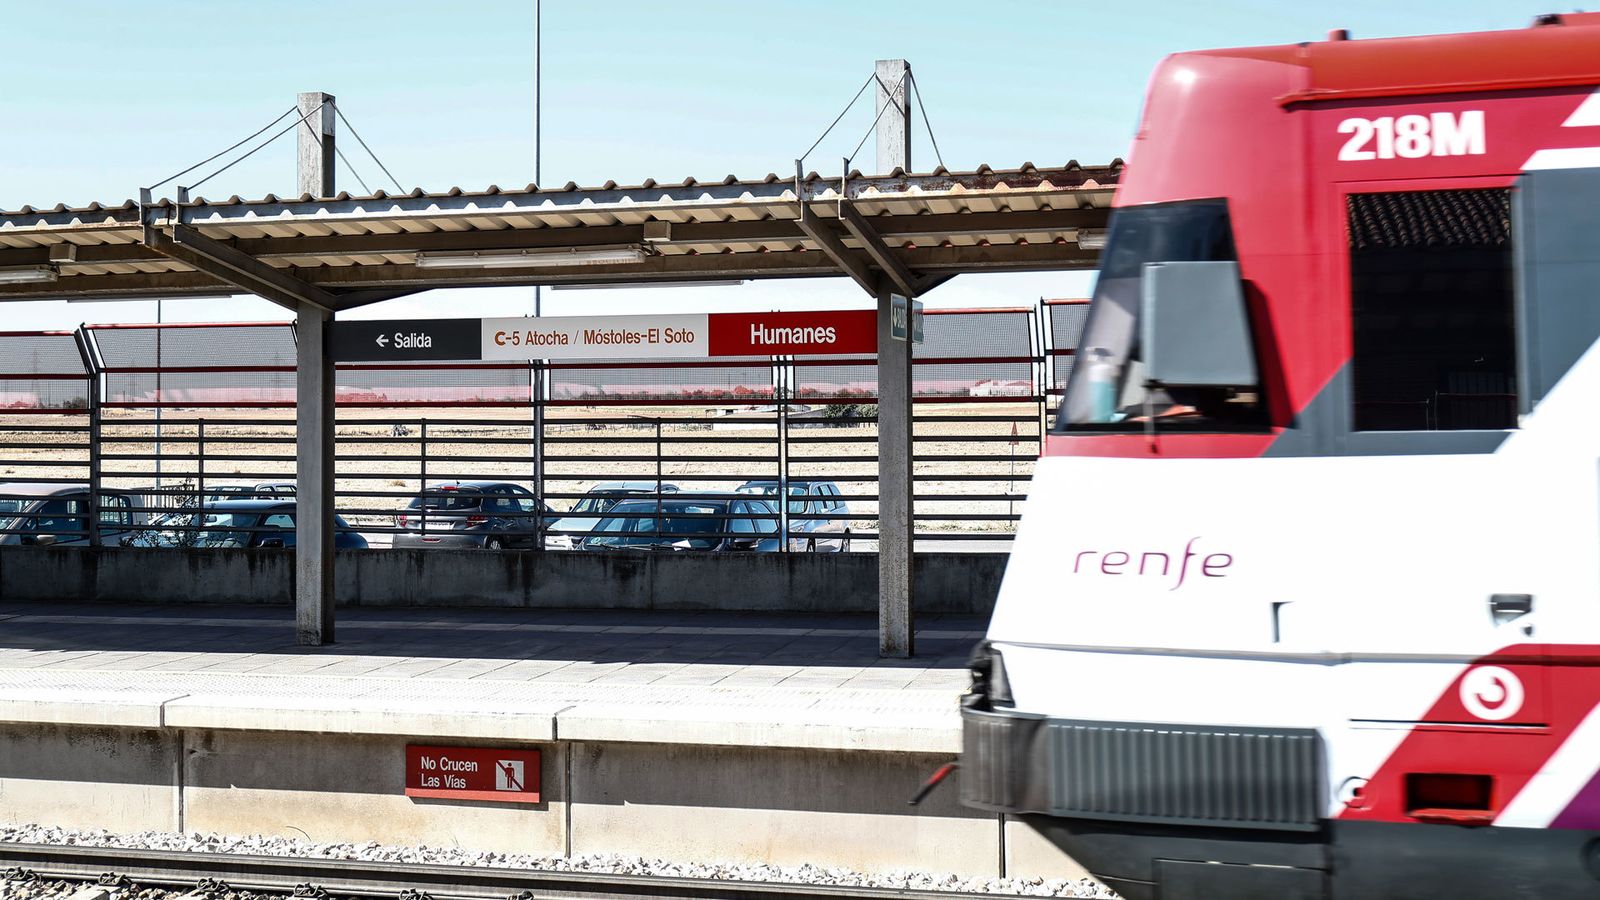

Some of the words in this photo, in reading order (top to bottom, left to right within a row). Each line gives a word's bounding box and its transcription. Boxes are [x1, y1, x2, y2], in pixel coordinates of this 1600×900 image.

[1337, 110, 1486, 161] 218M
[393, 331, 433, 349] Salida
[494, 330, 521, 346] C-5
[525, 330, 569, 346] Atocha
[583, 328, 660, 345] Móstoles-El
[664, 327, 695, 344] Soto
[750, 323, 836, 345] Humanes
[1073, 536, 1233, 591] renfe
[421, 756, 436, 770] No
[440, 756, 478, 772] Crucen
[421, 773, 440, 787] Las
[444, 774, 467, 789] Vías
